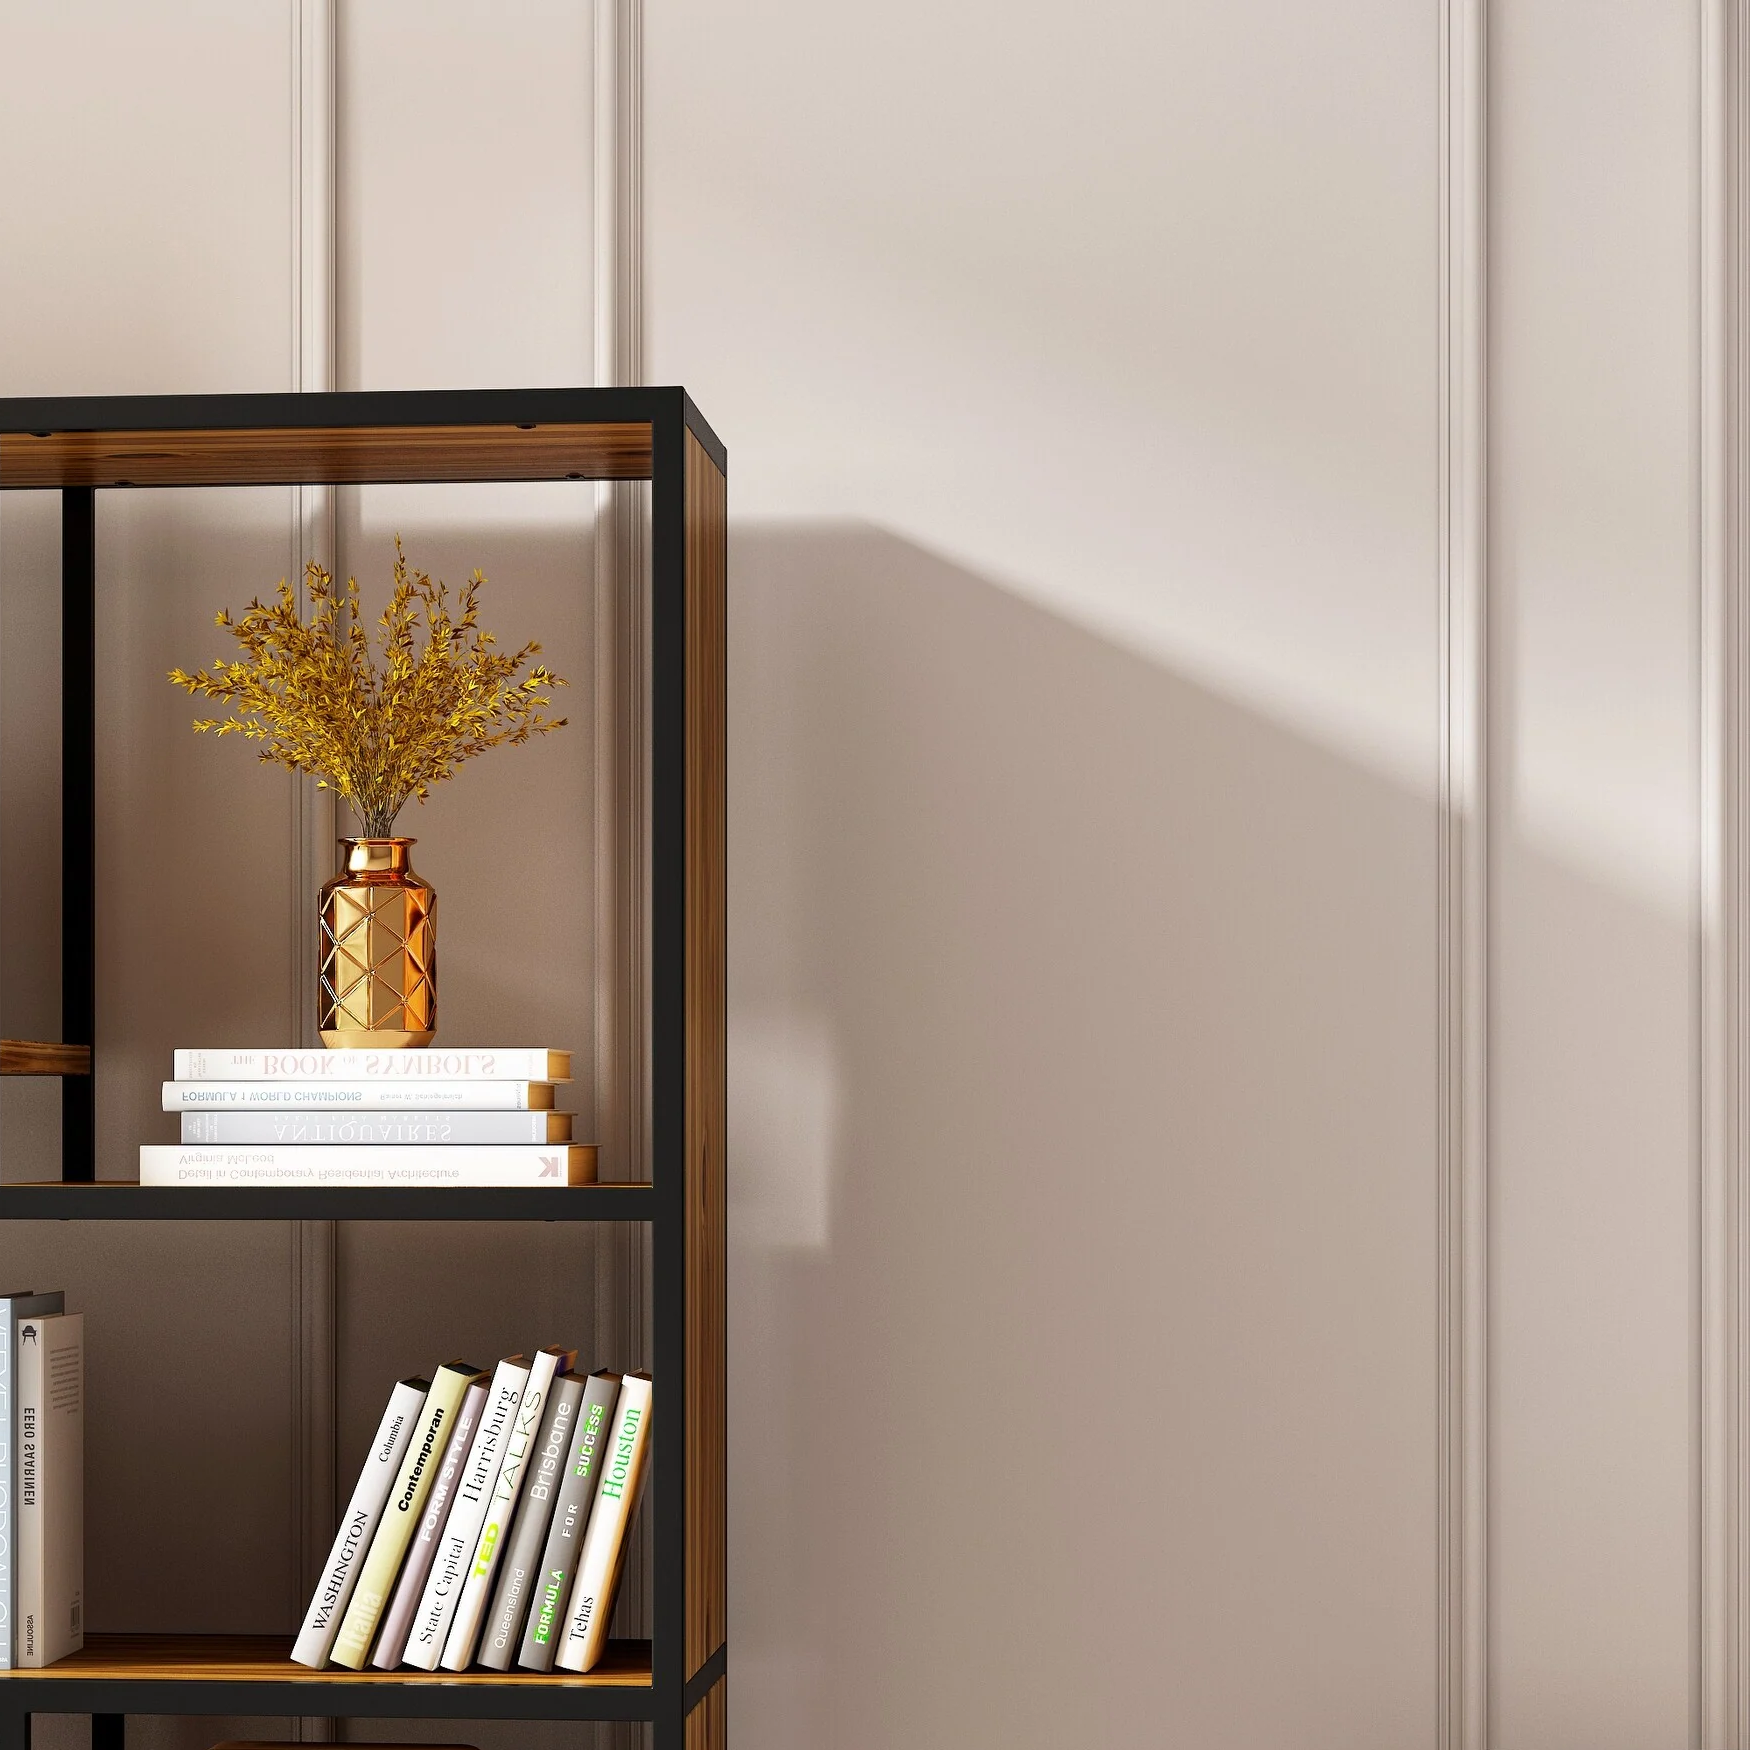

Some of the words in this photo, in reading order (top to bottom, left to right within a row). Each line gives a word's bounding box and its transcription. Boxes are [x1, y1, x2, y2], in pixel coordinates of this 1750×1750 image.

[313, 1510, 368, 1630] WASHINGTON
[379, 1415, 404, 1463] Columbia
[398, 1408, 444, 1512] Contemporan
[419, 1602, 444, 1644] State
[435, 1537, 465, 1596] Capital
[463, 1387, 519, 1502] Harrisburg
[421, 1486, 447, 1542] FORM
[443, 1416, 473, 1480] STYLE
[473, 1522, 499, 1579] TED
[493, 1391, 542, 1504] TALKS
[494, 1568, 524, 1649] Queensland
[530, 1402, 571, 1500] Brisbane
[533, 1569, 564, 1645] FORMULA
[561, 1503, 578, 1538] FOR
[574, 1404, 605, 1477] SUCCESS
[569, 1596, 594, 1642] Tehas
[602, 1407, 641, 1500] Houston
